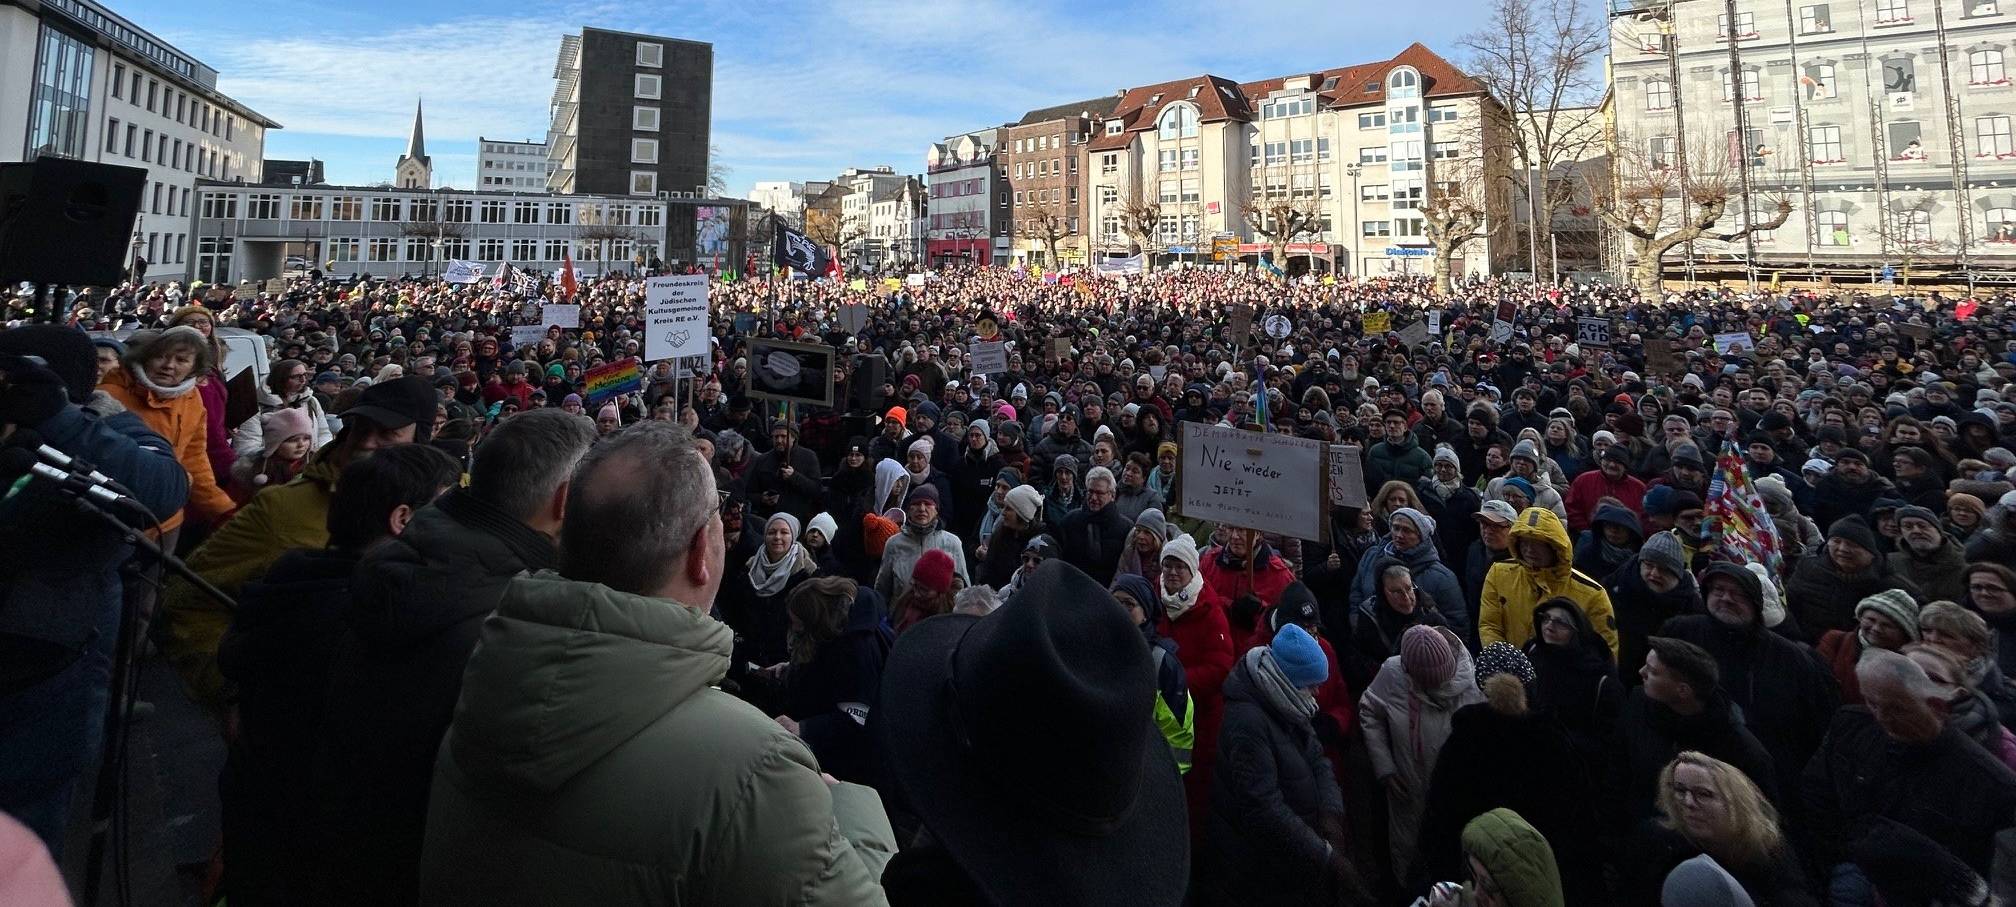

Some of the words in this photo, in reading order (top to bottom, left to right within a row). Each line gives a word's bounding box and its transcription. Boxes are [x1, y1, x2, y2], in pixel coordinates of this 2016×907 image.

[660, 297, 697, 305] Jüdischen
[648, 305, 706, 315] Kultusgemeinde
[654, 317, 674, 325] Kreis
[1579, 323, 1608, 333] FCK
[1579, 331, 1609, 341] AfD
[1201, 443, 1232, 471] Nie
[1242, 462, 1282, 478] wieder
[1213, 485, 1253, 498] JETZT
